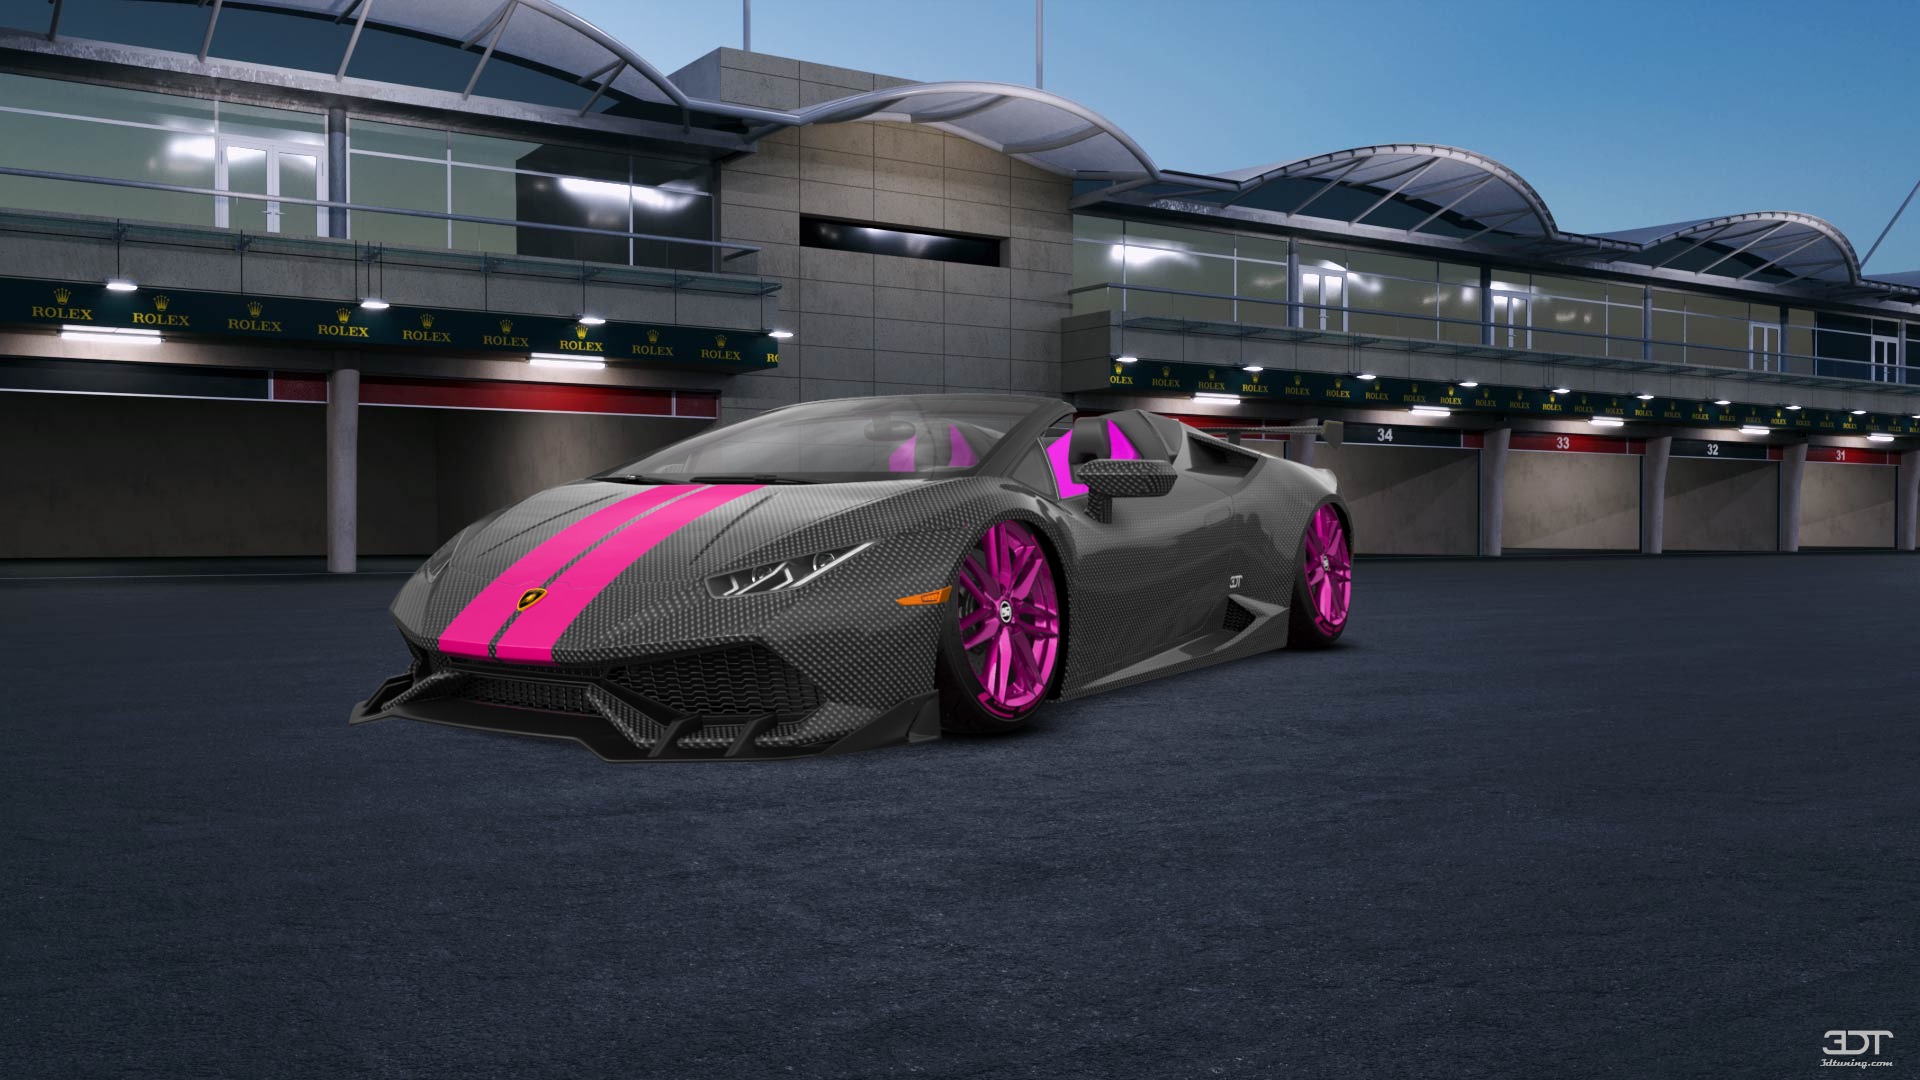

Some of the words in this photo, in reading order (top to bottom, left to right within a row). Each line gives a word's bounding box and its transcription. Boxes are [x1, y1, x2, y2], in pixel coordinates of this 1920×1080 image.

[32, 306, 93, 321] ROLEX
[133, 312, 190, 327] ROLEX
[228, 318, 282, 332] ROLEX
[318, 324, 370, 338] ROLEX
[403, 330, 451, 343] ROLEX
[483, 335, 529, 347] ROLEX
[560, 340, 603, 352] ROLEX
[632, 344, 674, 357] ROLEX
[701, 349, 741, 361] ROLEX
[1109, 375, 1134, 385] OLEX
[1152, 378, 1181, 388] ROLEX
[1198, 381, 1225, 391] ROLEX
[1242, 384, 1269, 393] ROLEX
[1285, 387, 1311, 396] ROLEX
[1326, 389, 1351, 398] ROLEX
[1365, 392, 1389, 400] ROLEX
[1403, 394, 1426, 403] ROLEX
[1440, 397, 1462, 405] ROLEX
[1475, 399, 1497, 407] ROLEX
[1377, 428, 1393, 442] 34
[1556, 436, 1570, 449] 33
[1707, 443, 1719, 456] 32
[1836, 449, 1846, 461] 31
[1229, 575, 1243, 589] 3DT
